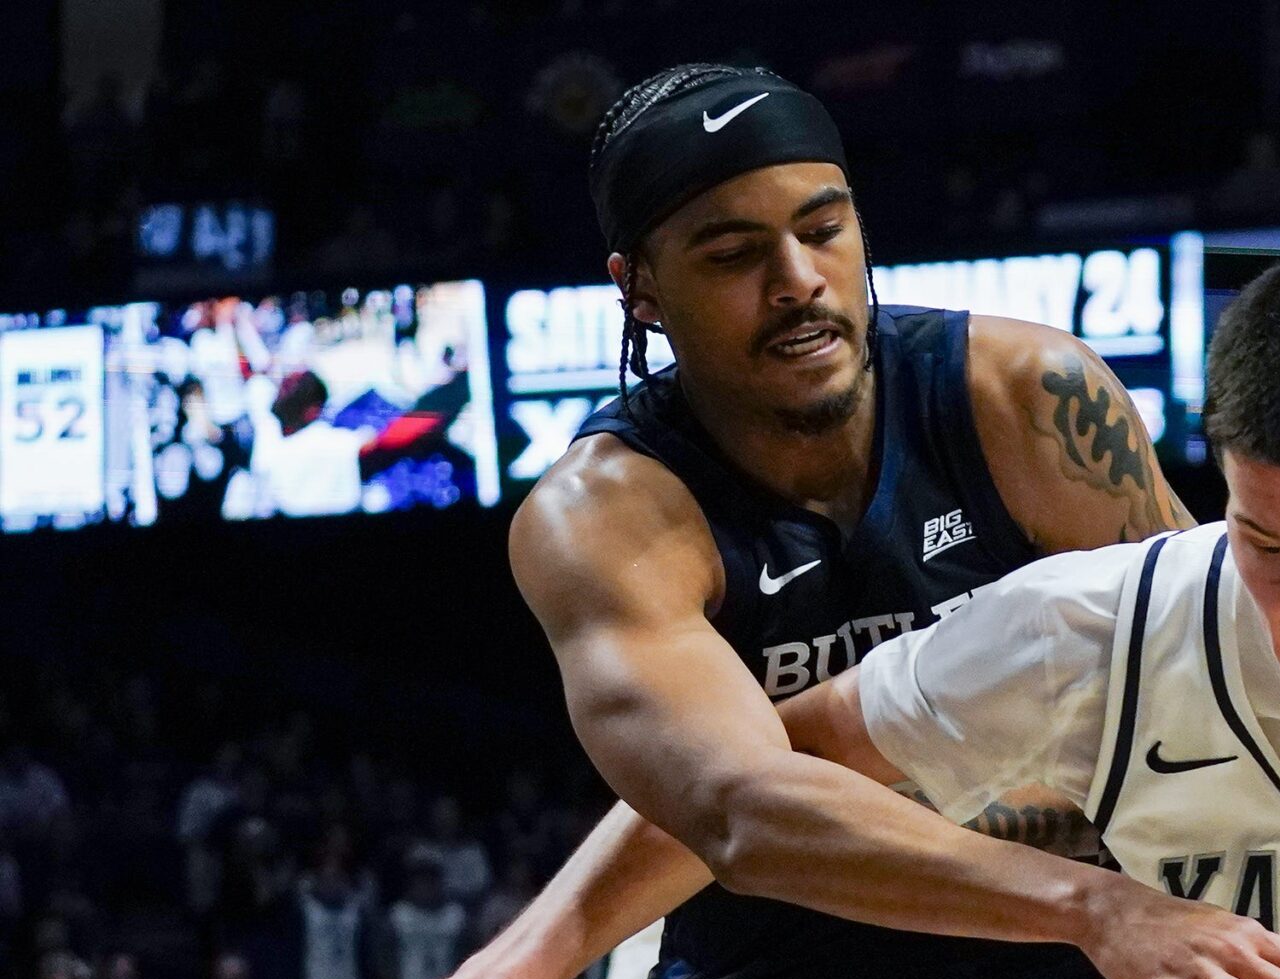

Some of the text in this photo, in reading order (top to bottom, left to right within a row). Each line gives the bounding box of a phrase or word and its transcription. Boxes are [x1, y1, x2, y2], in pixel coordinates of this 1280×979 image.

[1082, 248, 1164, 338] 24
[14, 395, 88, 444] 52
[923, 509, 962, 538] BIG
[762, 592, 972, 698] BUT
